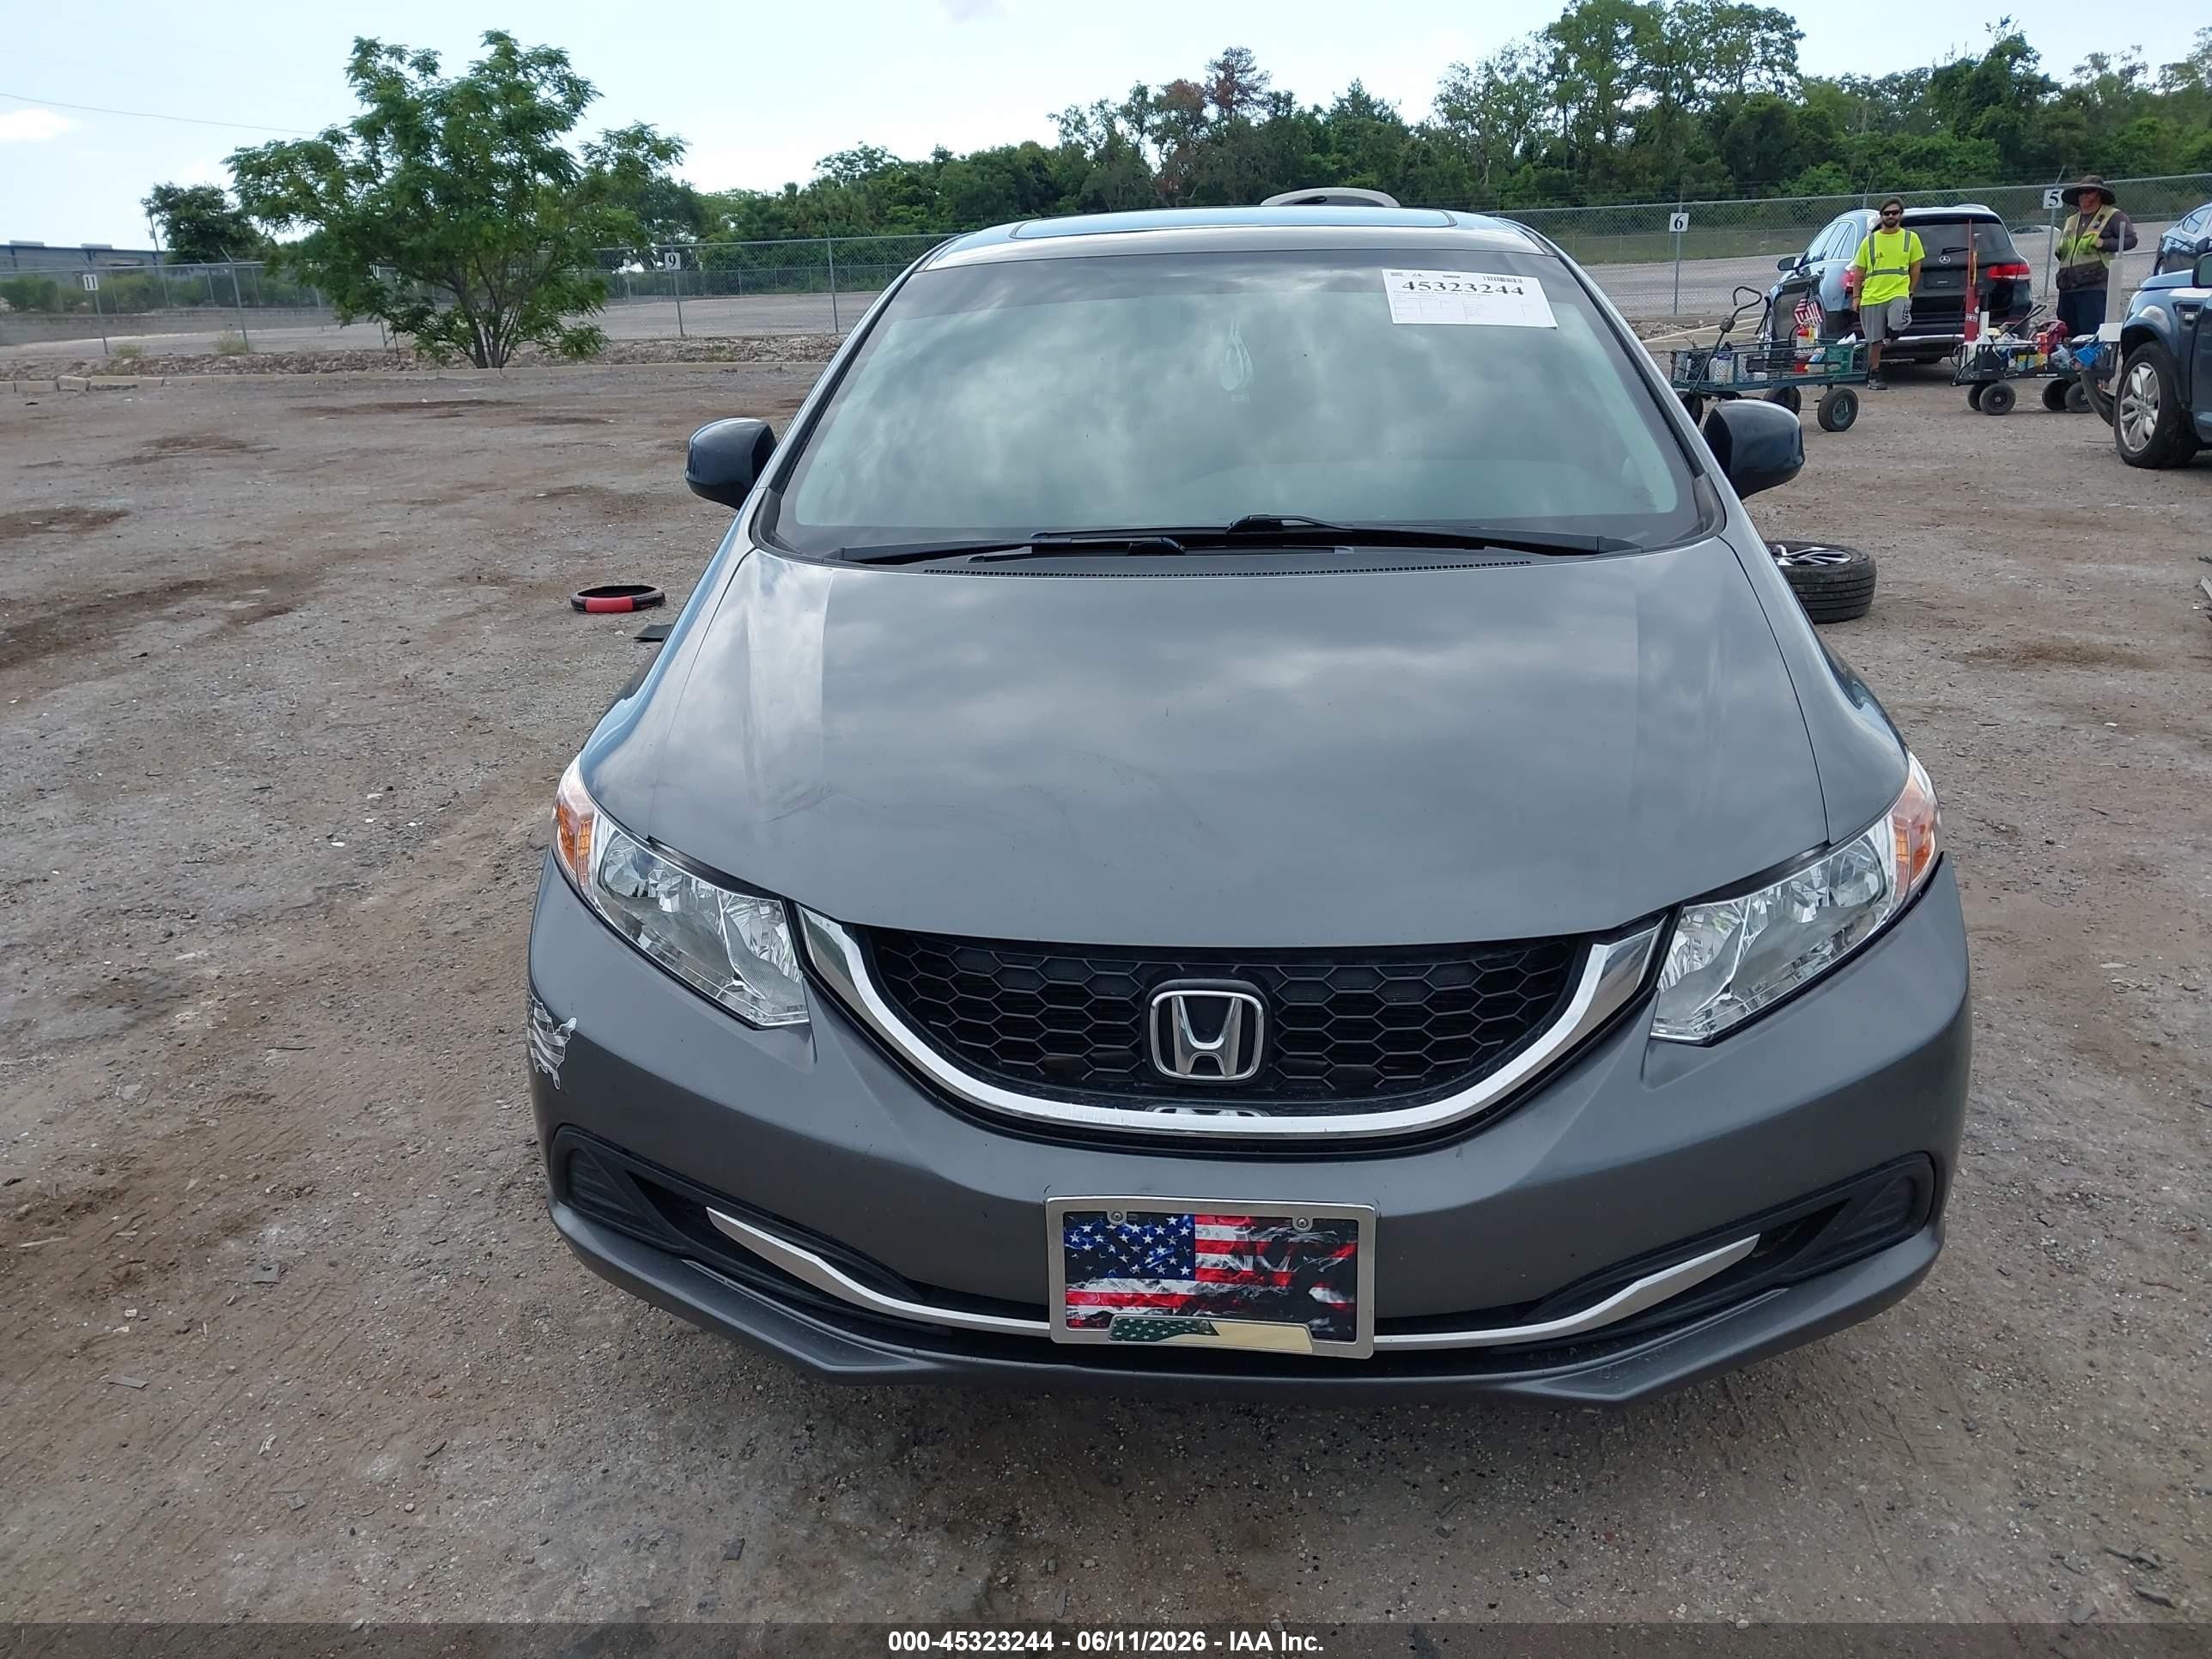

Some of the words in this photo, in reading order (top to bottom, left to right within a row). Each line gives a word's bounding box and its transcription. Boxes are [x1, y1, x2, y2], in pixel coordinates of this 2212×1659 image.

[2049, 191, 2059, 206] 5
[1674, 215, 1684, 229] 6
[669, 253, 677, 268] 9
[86, 276, 96, 289] 11
[1401, 281, 1525, 296] 45323244
